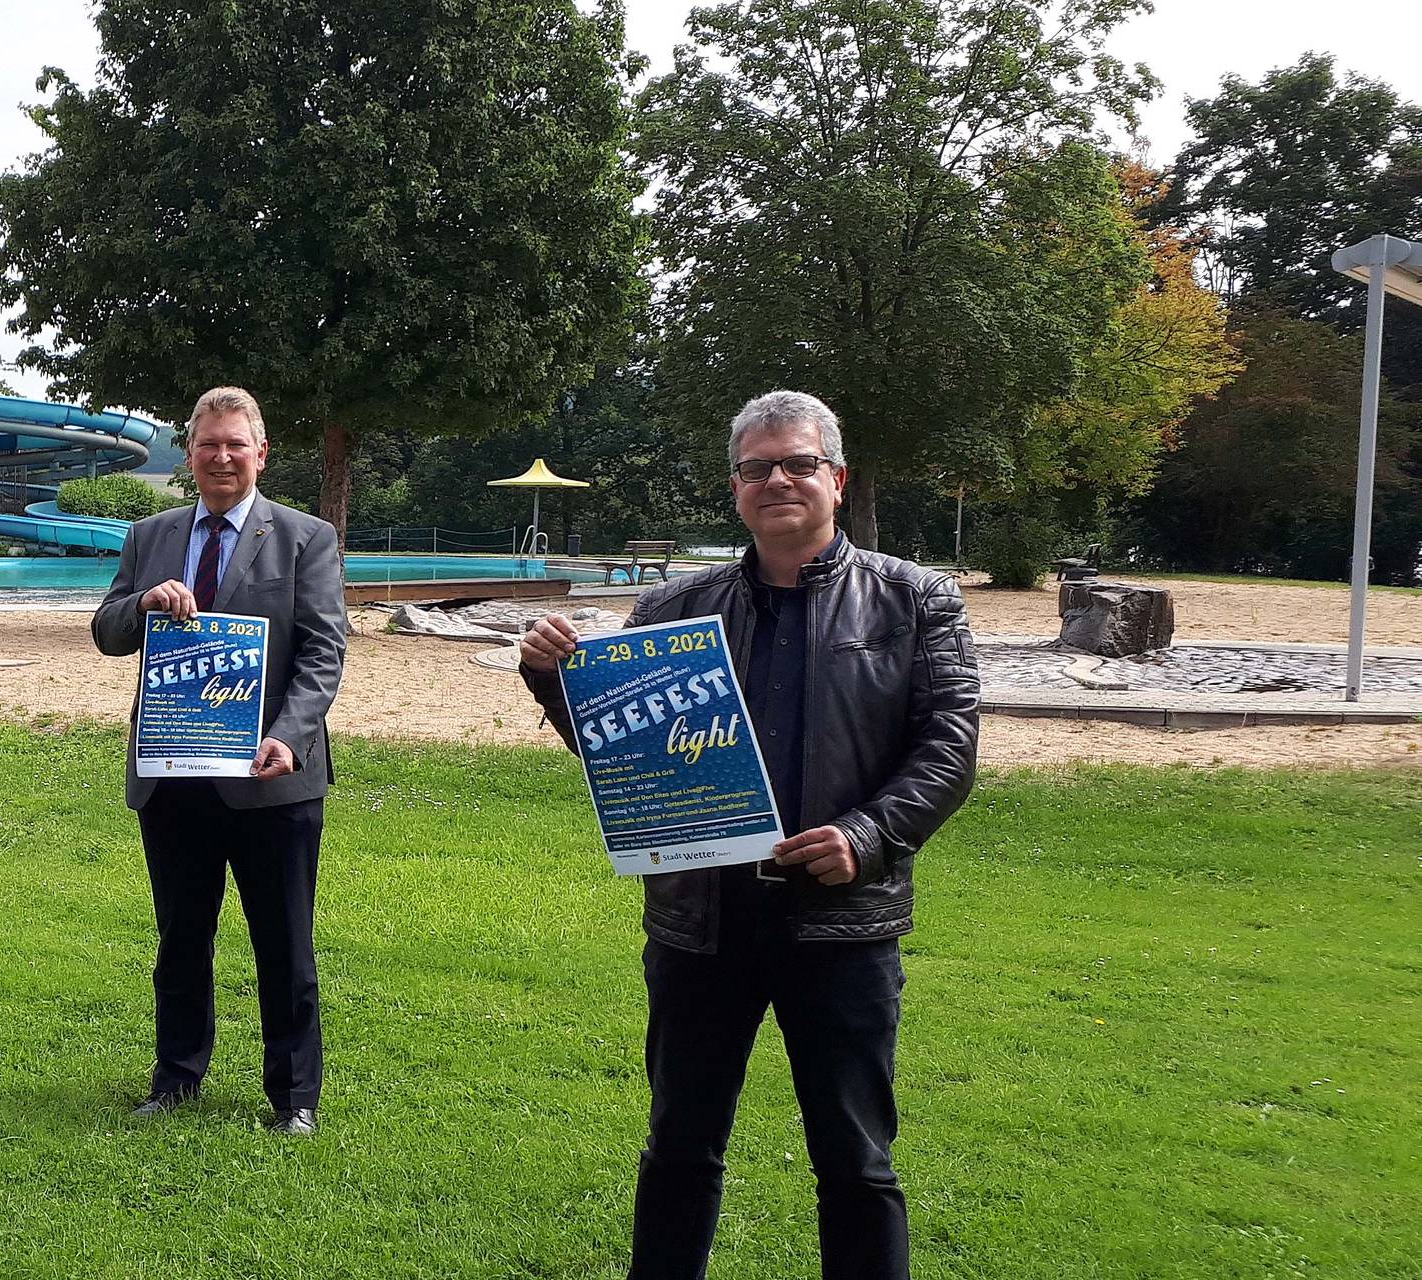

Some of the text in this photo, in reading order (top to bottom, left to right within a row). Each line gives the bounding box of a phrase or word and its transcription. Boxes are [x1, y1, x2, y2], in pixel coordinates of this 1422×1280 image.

[209, 621, 223, 634] 8.
[226, 622, 262, 638] 2021
[643, 639, 663, 658] 8.
[667, 629, 719, 655] 2021
[147, 647, 261, 689] SEEFEST
[200, 674, 259, 709] light
[576, 665, 672, 712] auf dem Naturbad-Gelände
[582, 667, 731, 752] SEEFEST
[666, 713, 741, 765] light
[187, 763, 211, 771] Wetter
[662, 852, 683, 861] Stadt
[683, 850, 716, 861] Wetter
